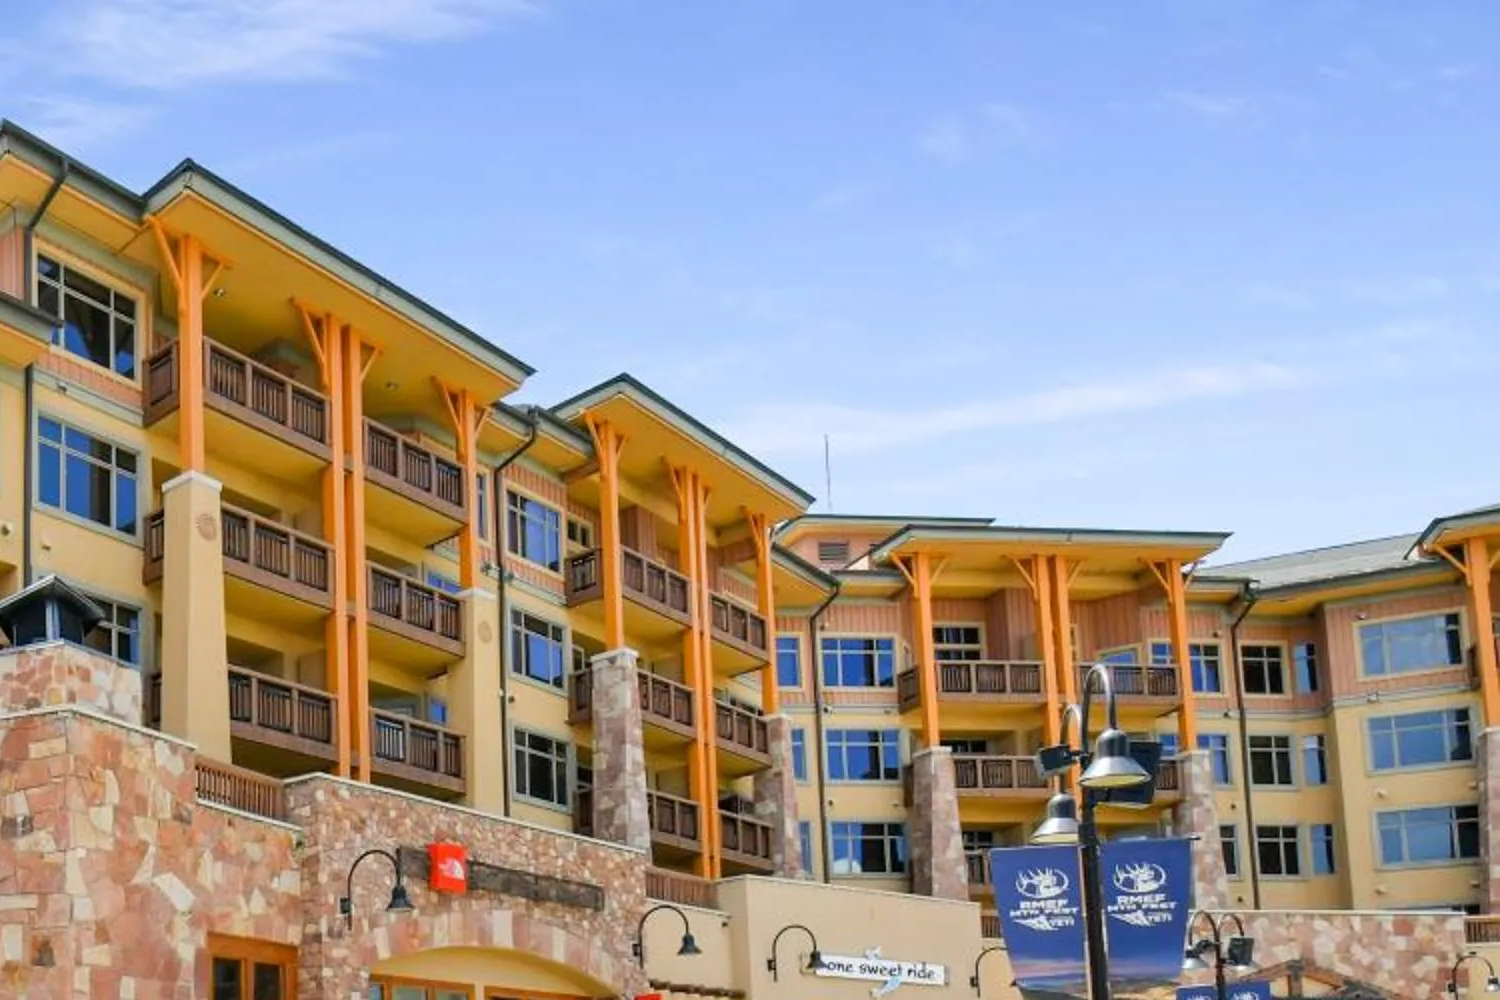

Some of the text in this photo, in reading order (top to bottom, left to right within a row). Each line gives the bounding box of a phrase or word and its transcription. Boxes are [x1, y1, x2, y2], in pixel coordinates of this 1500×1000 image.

[827, 961, 936, 980] one sweet ride
